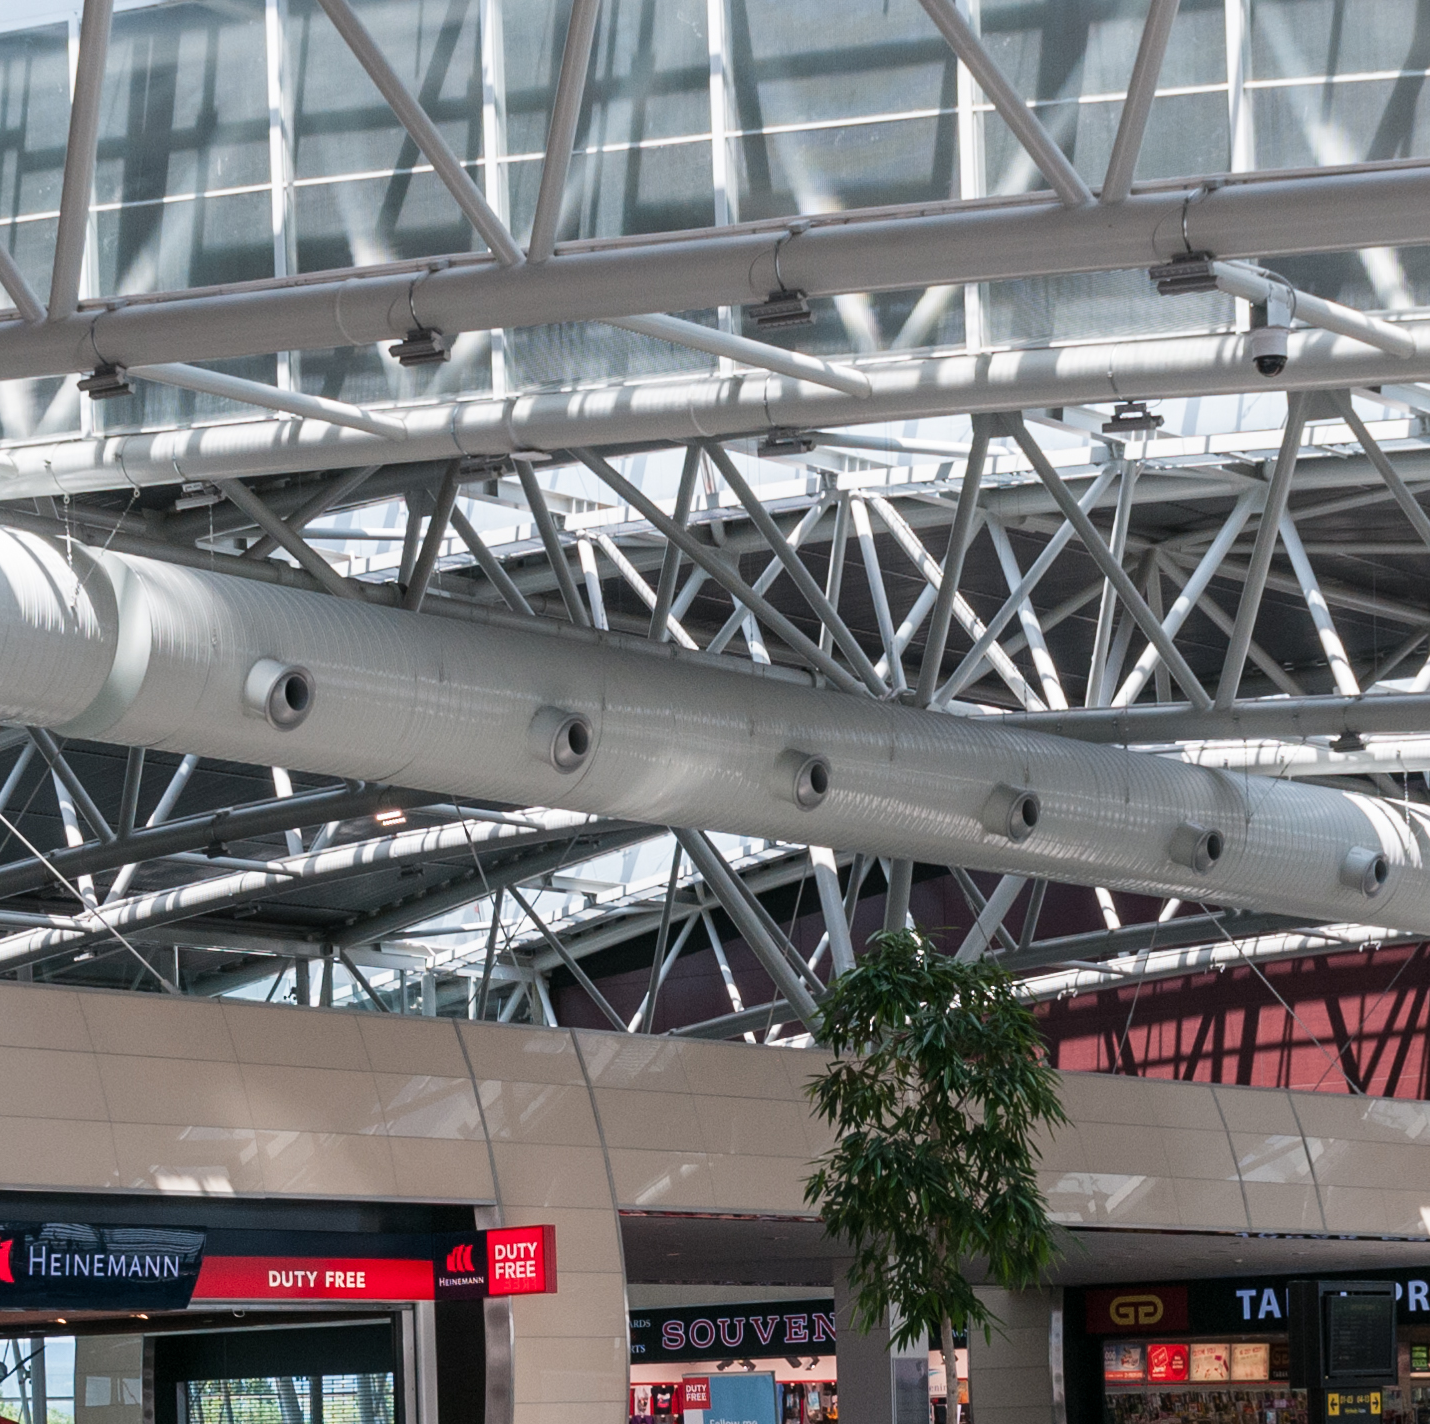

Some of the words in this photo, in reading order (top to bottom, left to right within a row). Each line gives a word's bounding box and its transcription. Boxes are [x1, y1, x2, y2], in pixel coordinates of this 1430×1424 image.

[494, 1241, 538, 1260] DUTY
[495, 1260, 537, 1280] FREE
[268, 1270, 318, 1288] DUTY
[325, 1271, 366, 1288] FREE
[629, 1319, 652, 1329] ARDS
[685, 1384, 707, 1393] DUTY
[686, 1393, 707, 1401] FREE
